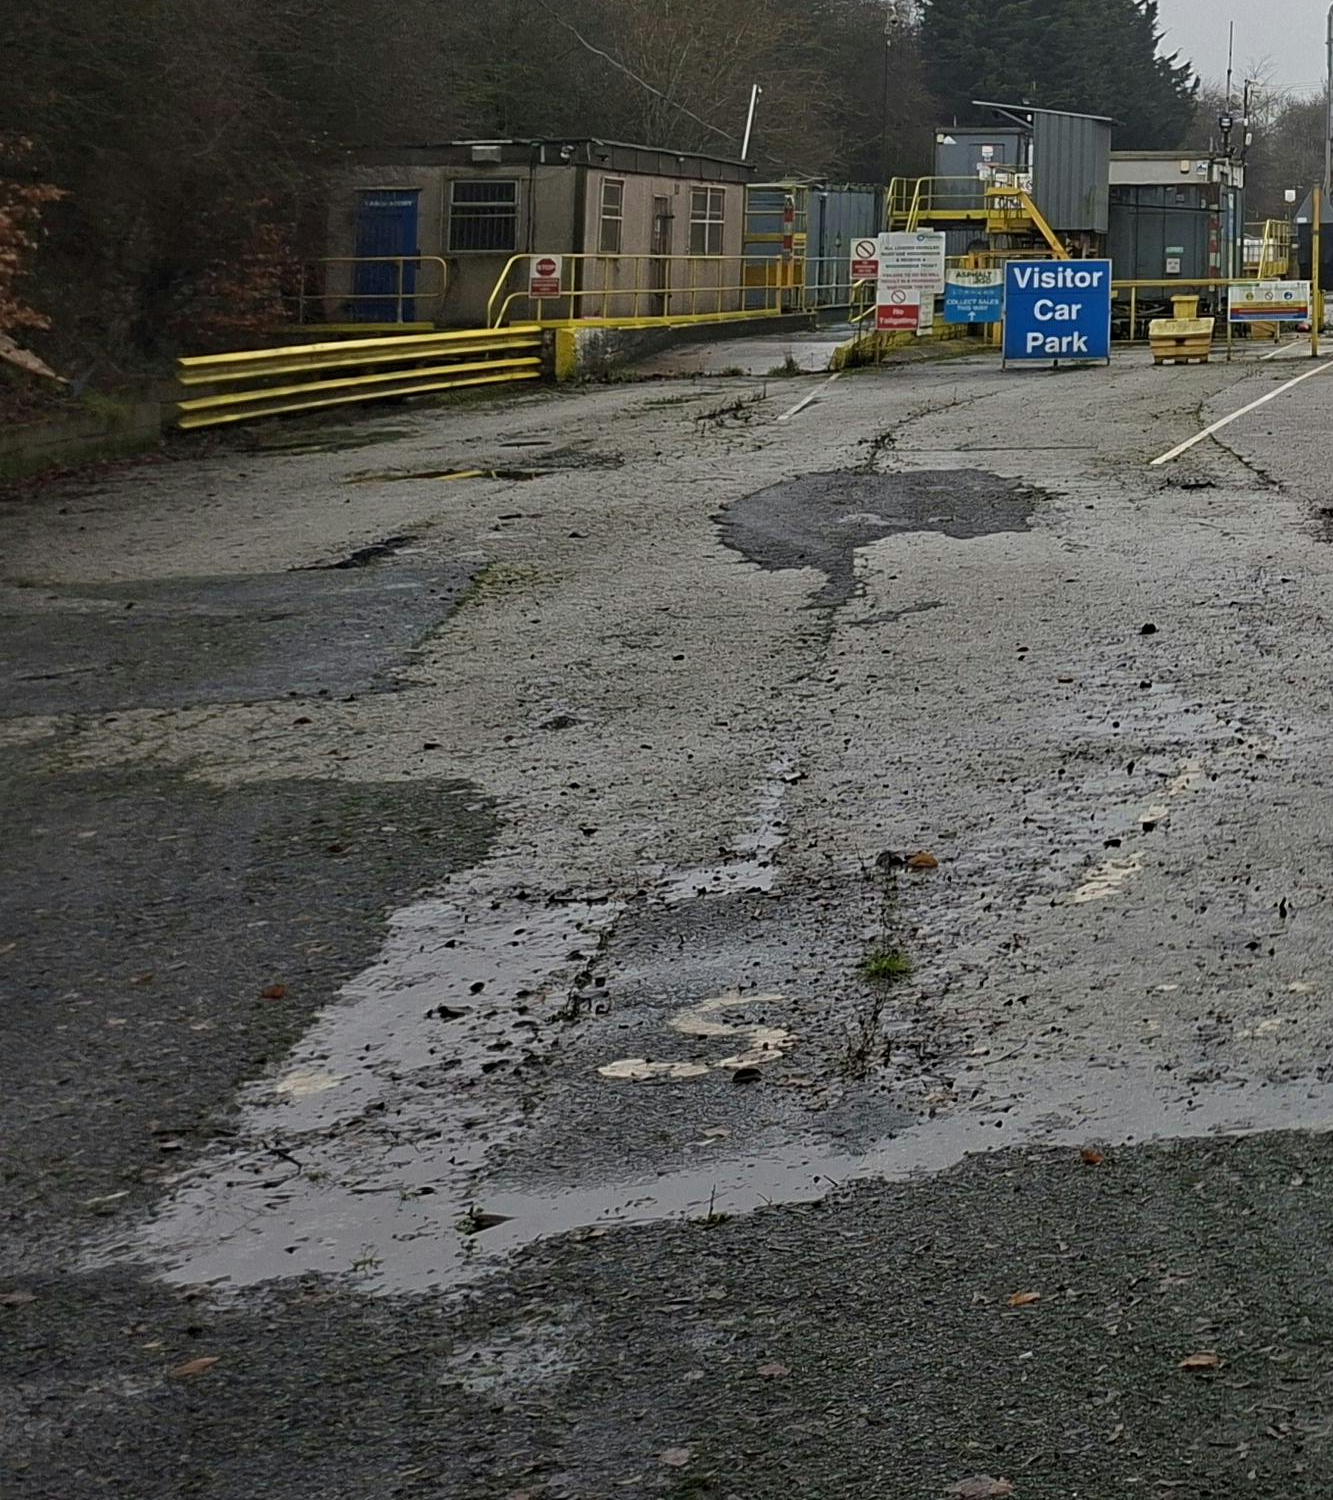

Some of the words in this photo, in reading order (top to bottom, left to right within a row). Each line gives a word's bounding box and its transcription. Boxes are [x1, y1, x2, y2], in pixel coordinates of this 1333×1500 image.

[1013, 266, 1103, 289] Visitor
[1033, 299, 1082, 321] Car
[1026, 331, 1088, 353] Park
